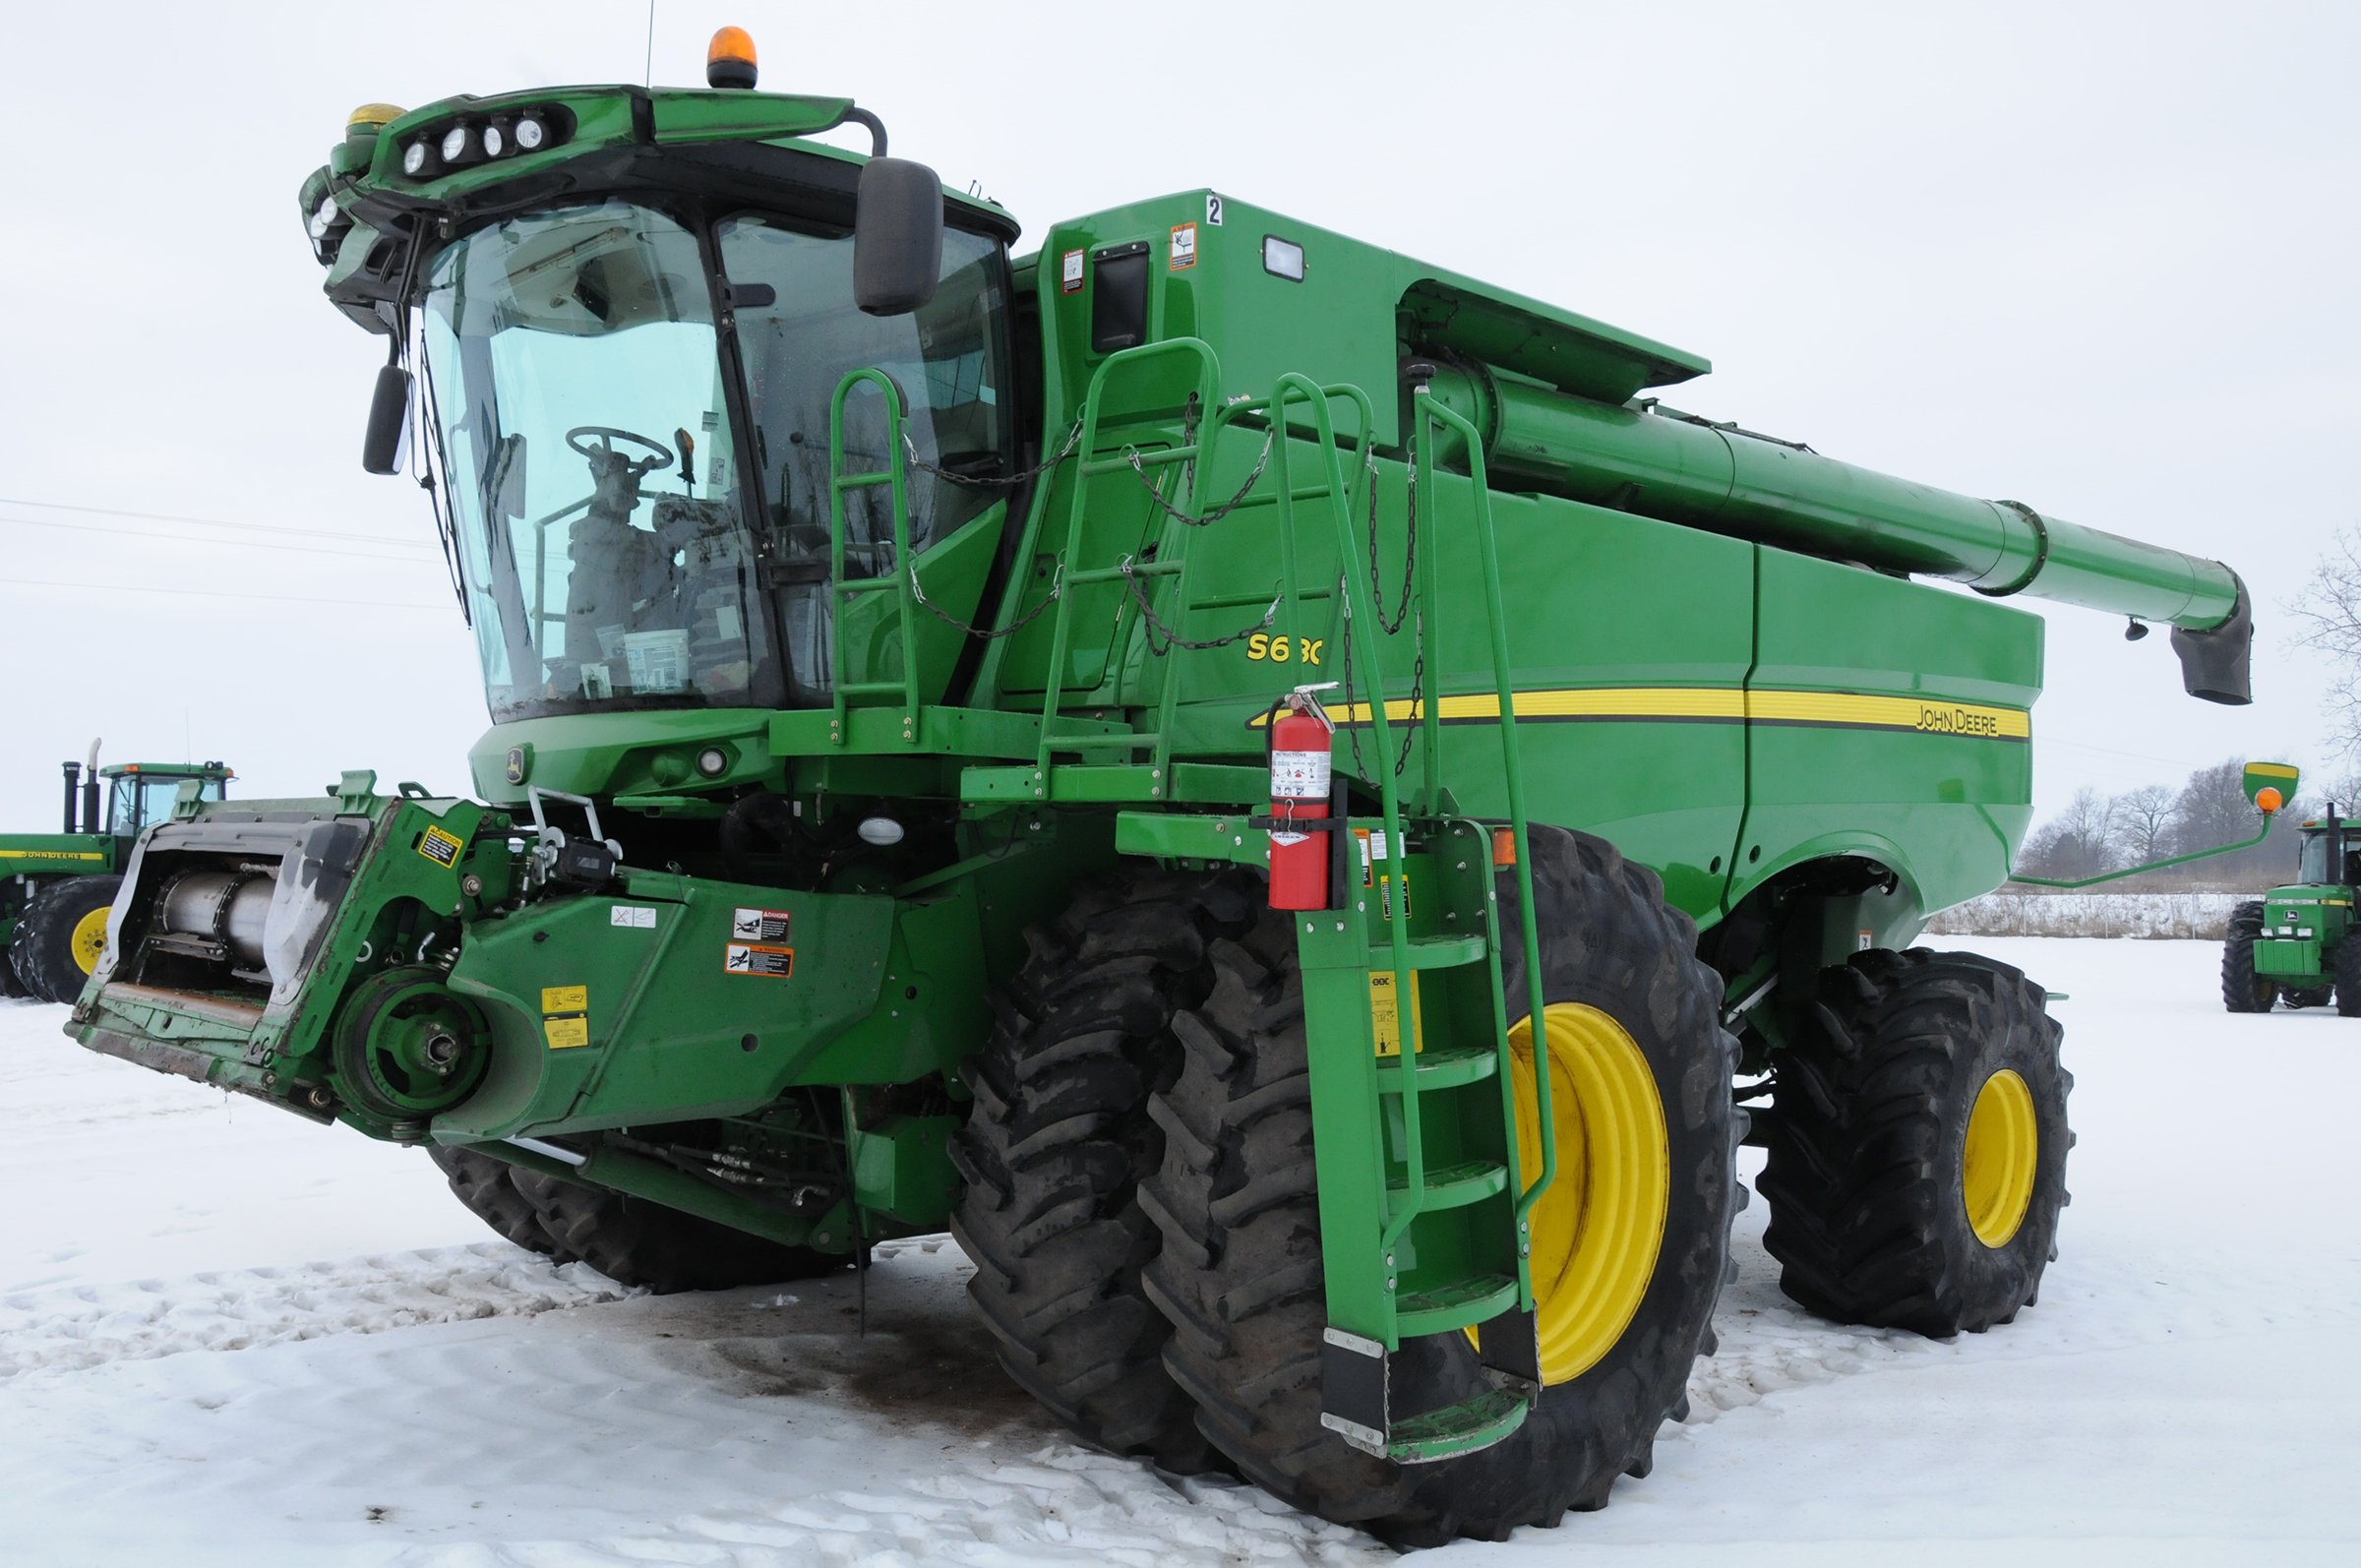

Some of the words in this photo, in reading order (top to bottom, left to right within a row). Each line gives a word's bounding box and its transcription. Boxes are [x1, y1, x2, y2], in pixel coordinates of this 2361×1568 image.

[1209, 199, 1220, 224] 2
[1916, 704, 1954, 730] JOHN
[1956, 708, 1998, 734] DEERE
[436, 828, 461, 847] CAUTION
